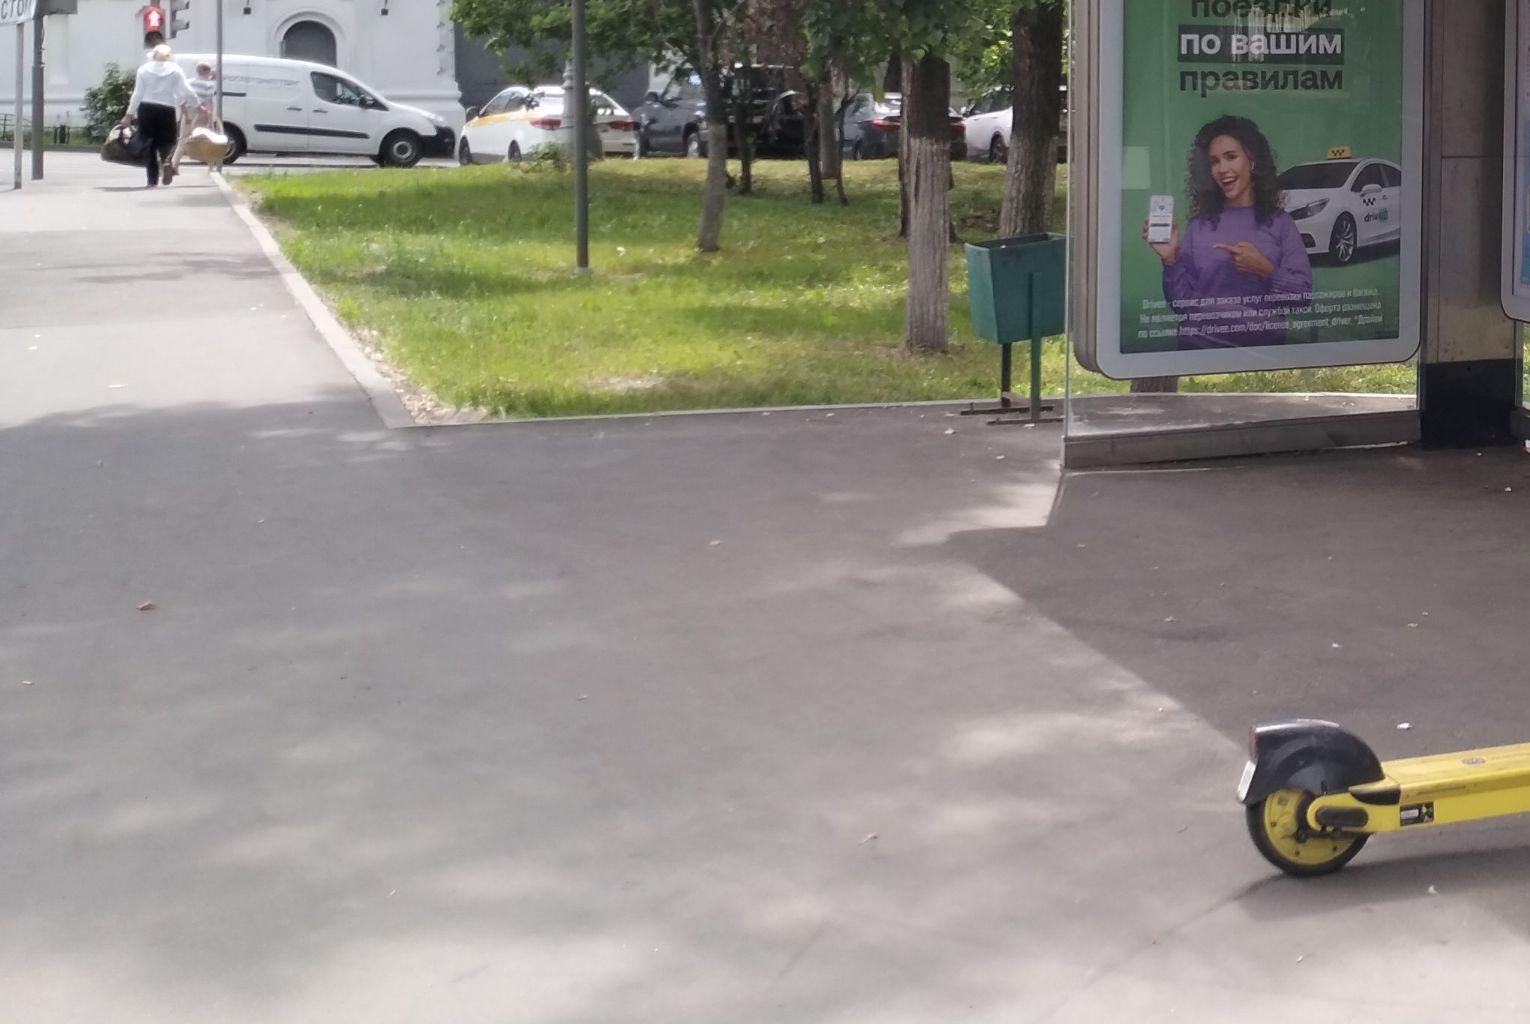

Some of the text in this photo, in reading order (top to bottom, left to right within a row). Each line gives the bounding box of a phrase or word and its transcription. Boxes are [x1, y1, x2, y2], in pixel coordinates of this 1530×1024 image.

[1180, 34, 1342, 55] по вашим
[1179, 69, 1343, 97] правилам
